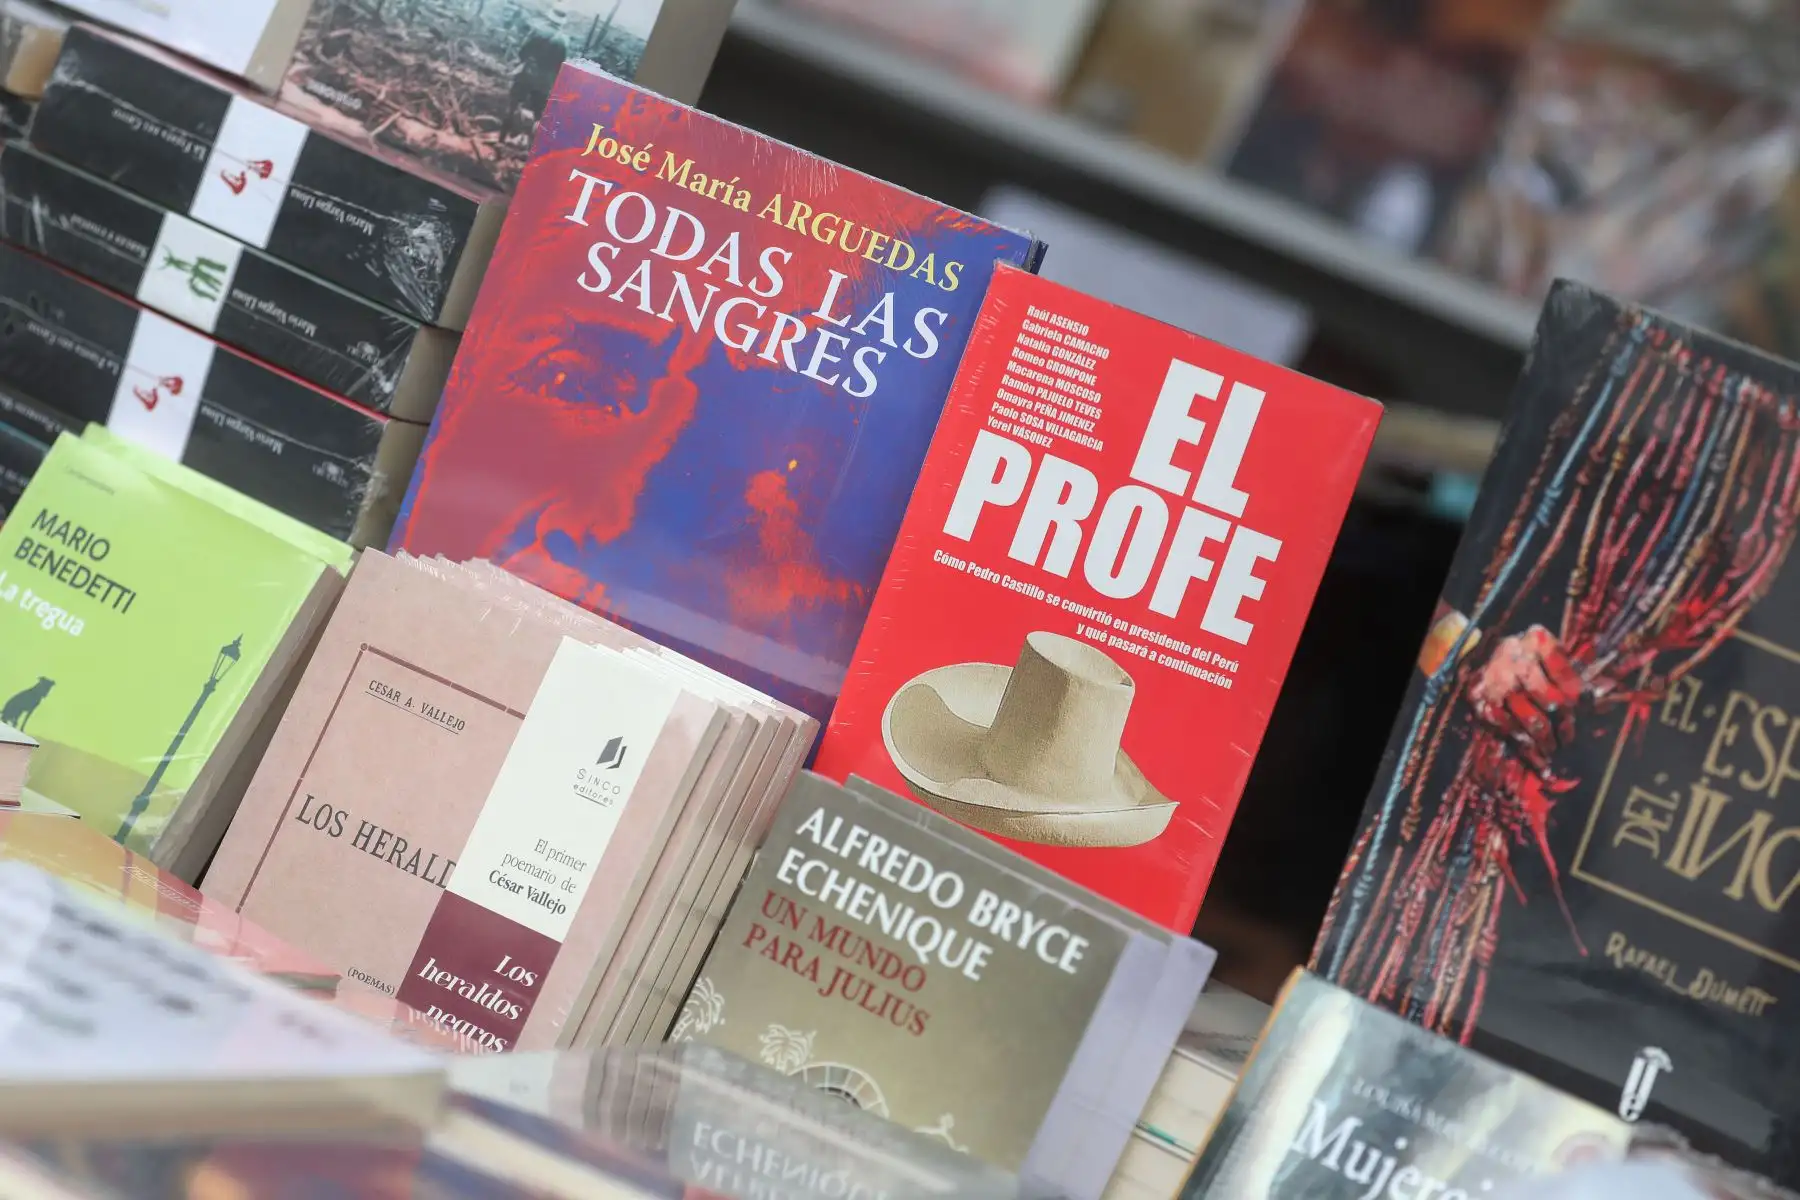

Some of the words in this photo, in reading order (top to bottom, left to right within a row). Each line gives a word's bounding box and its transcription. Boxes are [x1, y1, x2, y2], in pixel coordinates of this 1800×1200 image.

[313, 197, 347, 223] Vargas
[344, 214, 374, 236] Mario
[581, 123, 652, 171] José
[655, 151, 751, 212] María
[757, 193, 964, 292] ARGUEDAS
[564, 169, 792, 298] TODAS
[812, 269, 948, 359] LAS
[256, 298, 290, 324] Vargas
[286, 315, 317, 337] Mario
[577, 242, 886, 398] SANGRES
[1027, 305, 1050, 321] Raúl
[1049, 313, 1089, 336] ASENSIO
[1016, 332, 1051, 354] Natalia
[1051, 345, 1097, 371] GONZÁLEZ
[1022, 319, 1062, 342] Gabriela
[1063, 334, 1110, 360] CAMACHO
[1006, 360, 1055, 386] Macarena
[1055, 378, 1102, 403] MOSCOSO
[1011, 346, 1045, 367] Romeo
[1046, 360, 1097, 386] GROMPONE
[991, 401, 1019, 420] Paolo
[1019, 412, 1044, 430] SOSA
[996, 388, 1034, 410] Omayra
[1034, 401, 1058, 419] PEÑA
[1001, 374, 1035, 395] Ramón
[1035, 386, 1074, 409] PAJUELO
[1074, 400, 1102, 420] TEVES
[987, 415, 1012, 433] Yerel
[1012, 424, 1053, 448] VÁSQUEZ
[1129, 358, 1266, 518] EL
[31, 508, 110, 562] MARIO
[942, 429, 1282, 646] PROFE
[14, 536, 137, 614] BENEDETTI
[19, 588, 85, 636] tregua
[933, 549, 966, 572] Cómo
[966, 561, 1000, 584] Pedro
[1001, 575, 1045, 601] Castillo
[1045, 593, 1060, 607] se
[1061, 599, 1112, 626] convirtió
[1113, 619, 1128, 632] en
[1128, 624, 1191, 655] presidente
[1191, 646, 1211, 663] del
[1211, 653, 1239, 673] Perú
[1076, 623, 1085, 635] y
[1085, 626, 1107, 643] qué
[1107, 634, 1148, 658] pasará
[1148, 650, 1156, 662] a
[1157, 654, 1233, 689] continuación
[368, 680, 401, 702] CESAR
[420, 702, 465, 731] VALLEJO
[295, 794, 349, 838] LOS
[573, 783, 615, 806] editores
[500, 853, 557, 886] poemario
[560, 877, 577, 894] de
[534, 838, 549, 853] El
[545, 847, 587, 873] primer
[489, 869, 524, 895] César
[526, 885, 566, 915] Vallejo
[796, 807, 964, 909] ALFREDO
[968, 889, 1089, 974] BRYCE
[776, 847, 993, 982] ECHENIQUE
[761, 889, 808, 931] UN
[808, 915, 927, 993] MUNDO
[346, 966, 395, 997] (POEMAS)
[417, 957, 523, 1020] heraldos
[493, 955, 539, 987] Los
[742, 923, 820, 983] PARA
[818, 962, 930, 1037] JULIUS
